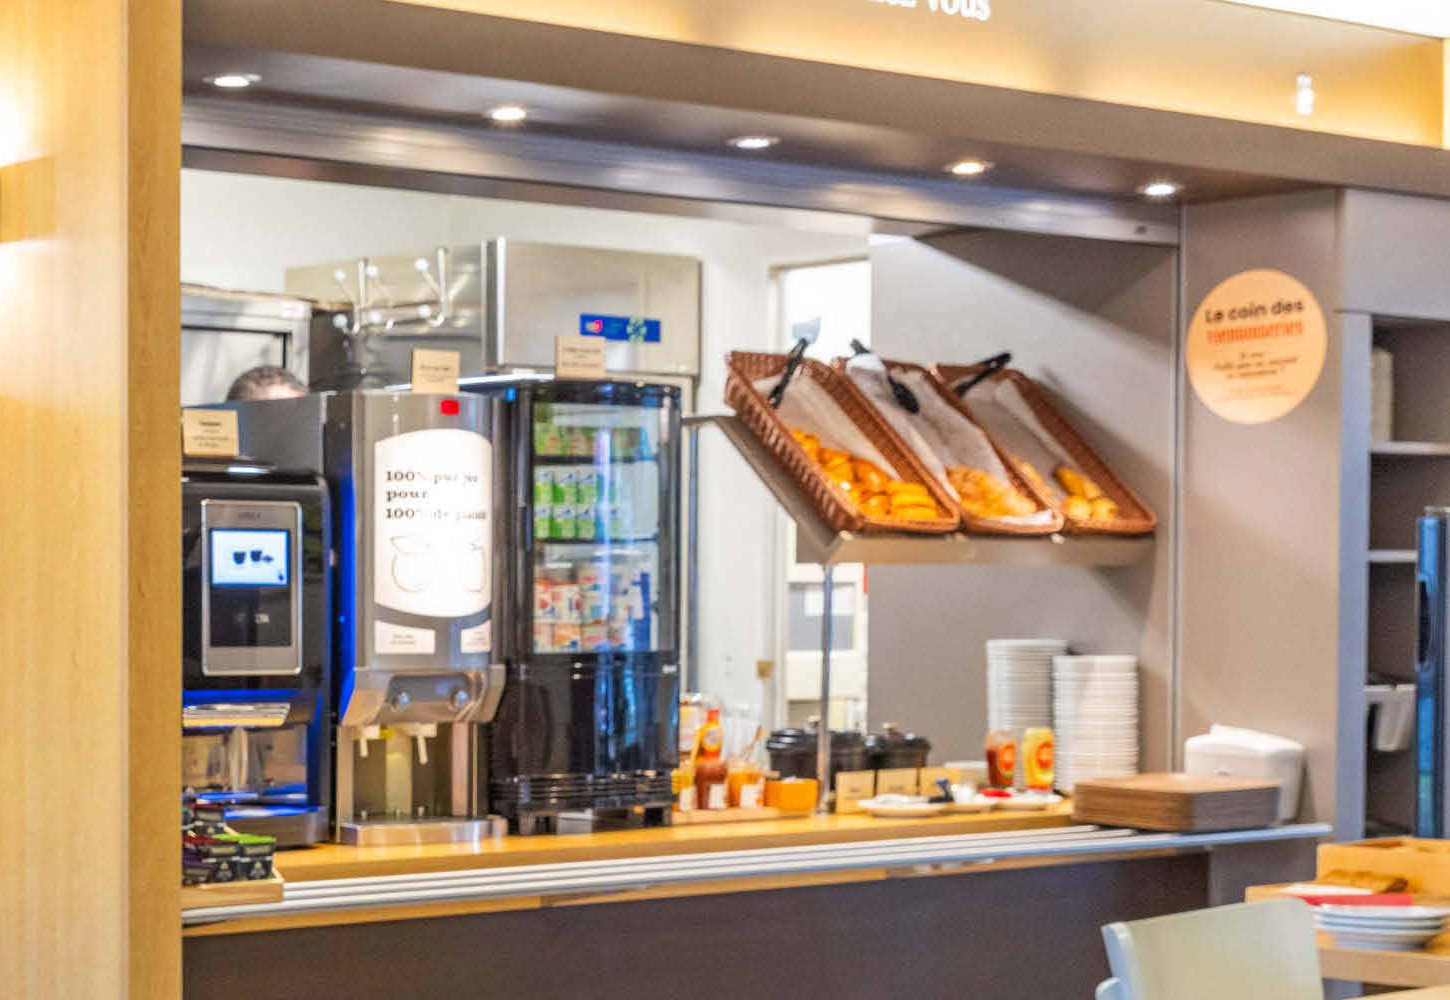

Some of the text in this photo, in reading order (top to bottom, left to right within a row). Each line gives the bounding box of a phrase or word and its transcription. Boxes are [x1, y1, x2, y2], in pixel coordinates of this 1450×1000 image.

[1204, 300, 1304, 323] Le coin des
[385, 488, 428, 502] pour
